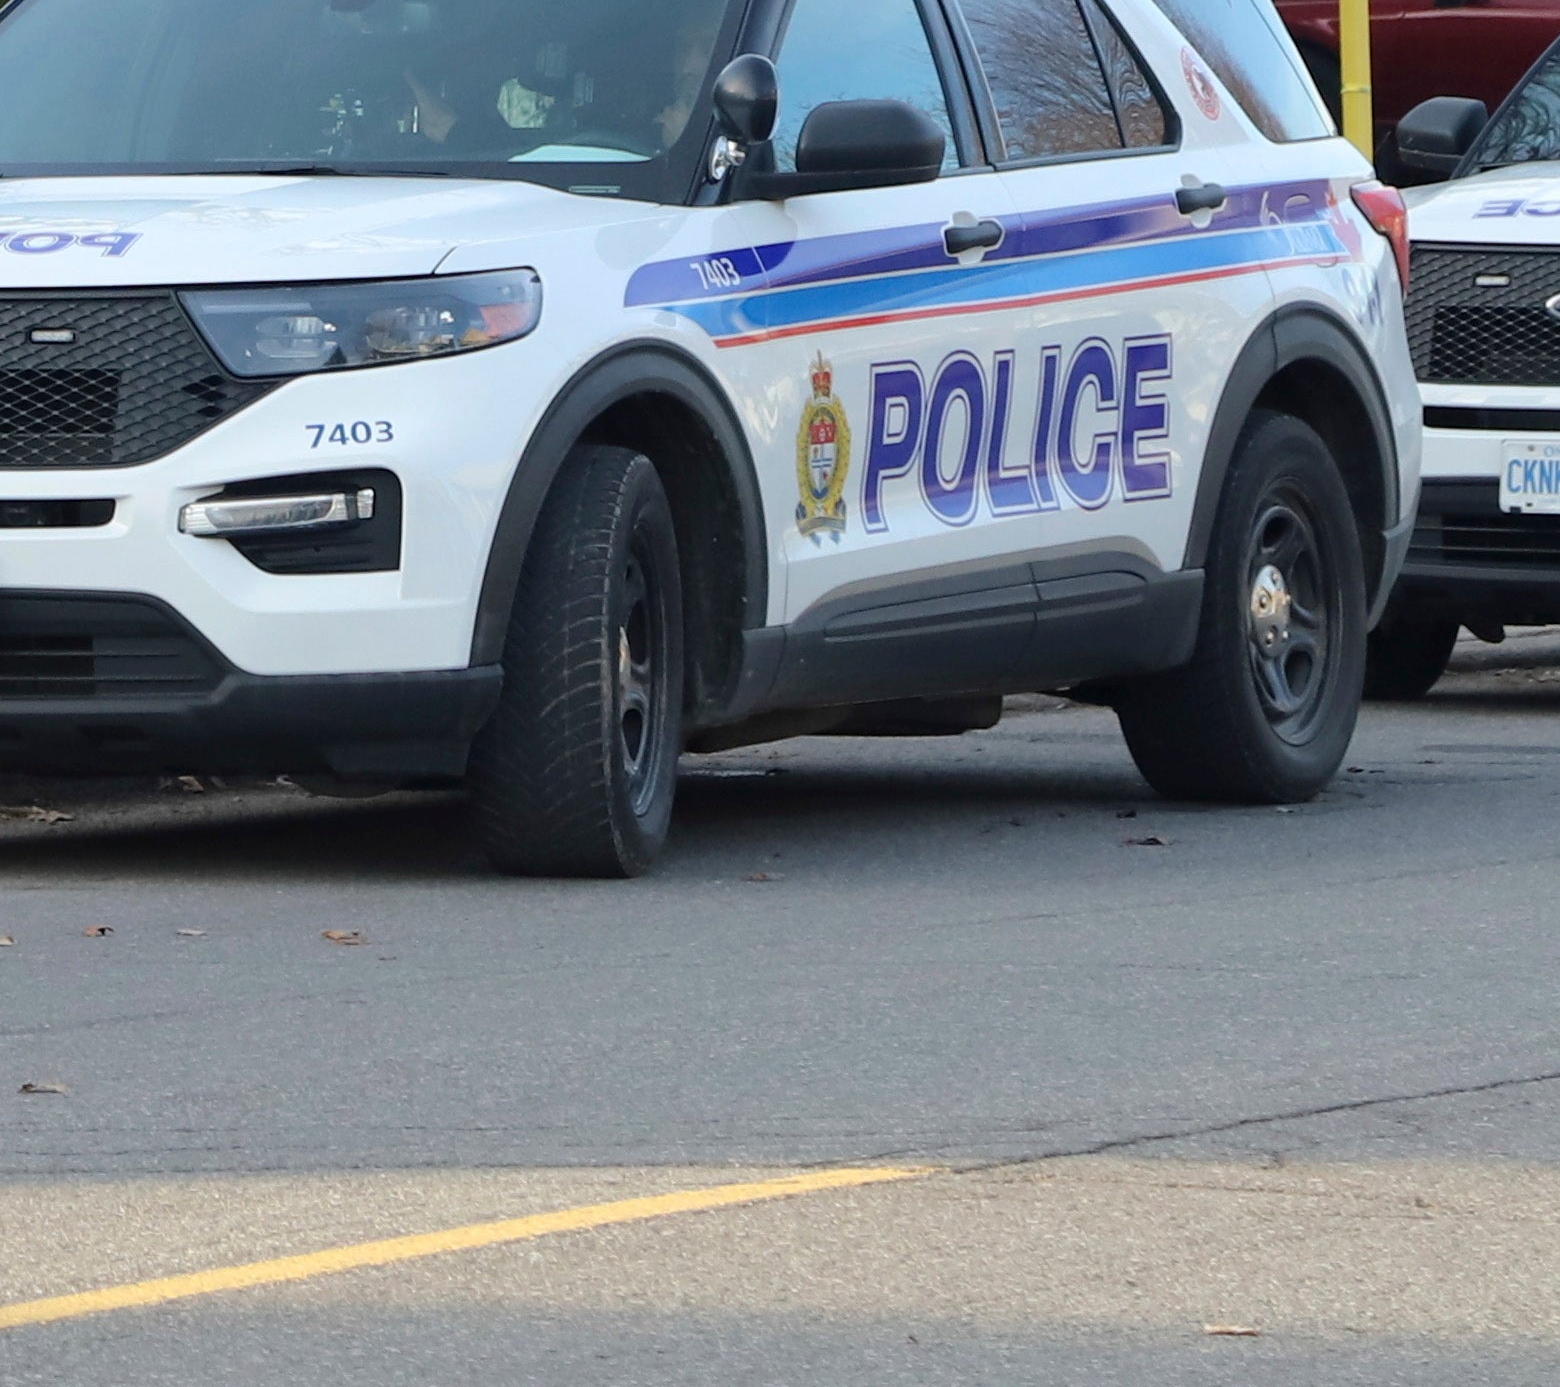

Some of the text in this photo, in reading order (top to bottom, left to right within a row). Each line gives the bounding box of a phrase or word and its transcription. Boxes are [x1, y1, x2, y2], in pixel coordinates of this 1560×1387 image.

[689, 257, 741, 290] 7403
[304, 420, 395, 449] 7403
[860, 332, 1173, 535] POLICE
